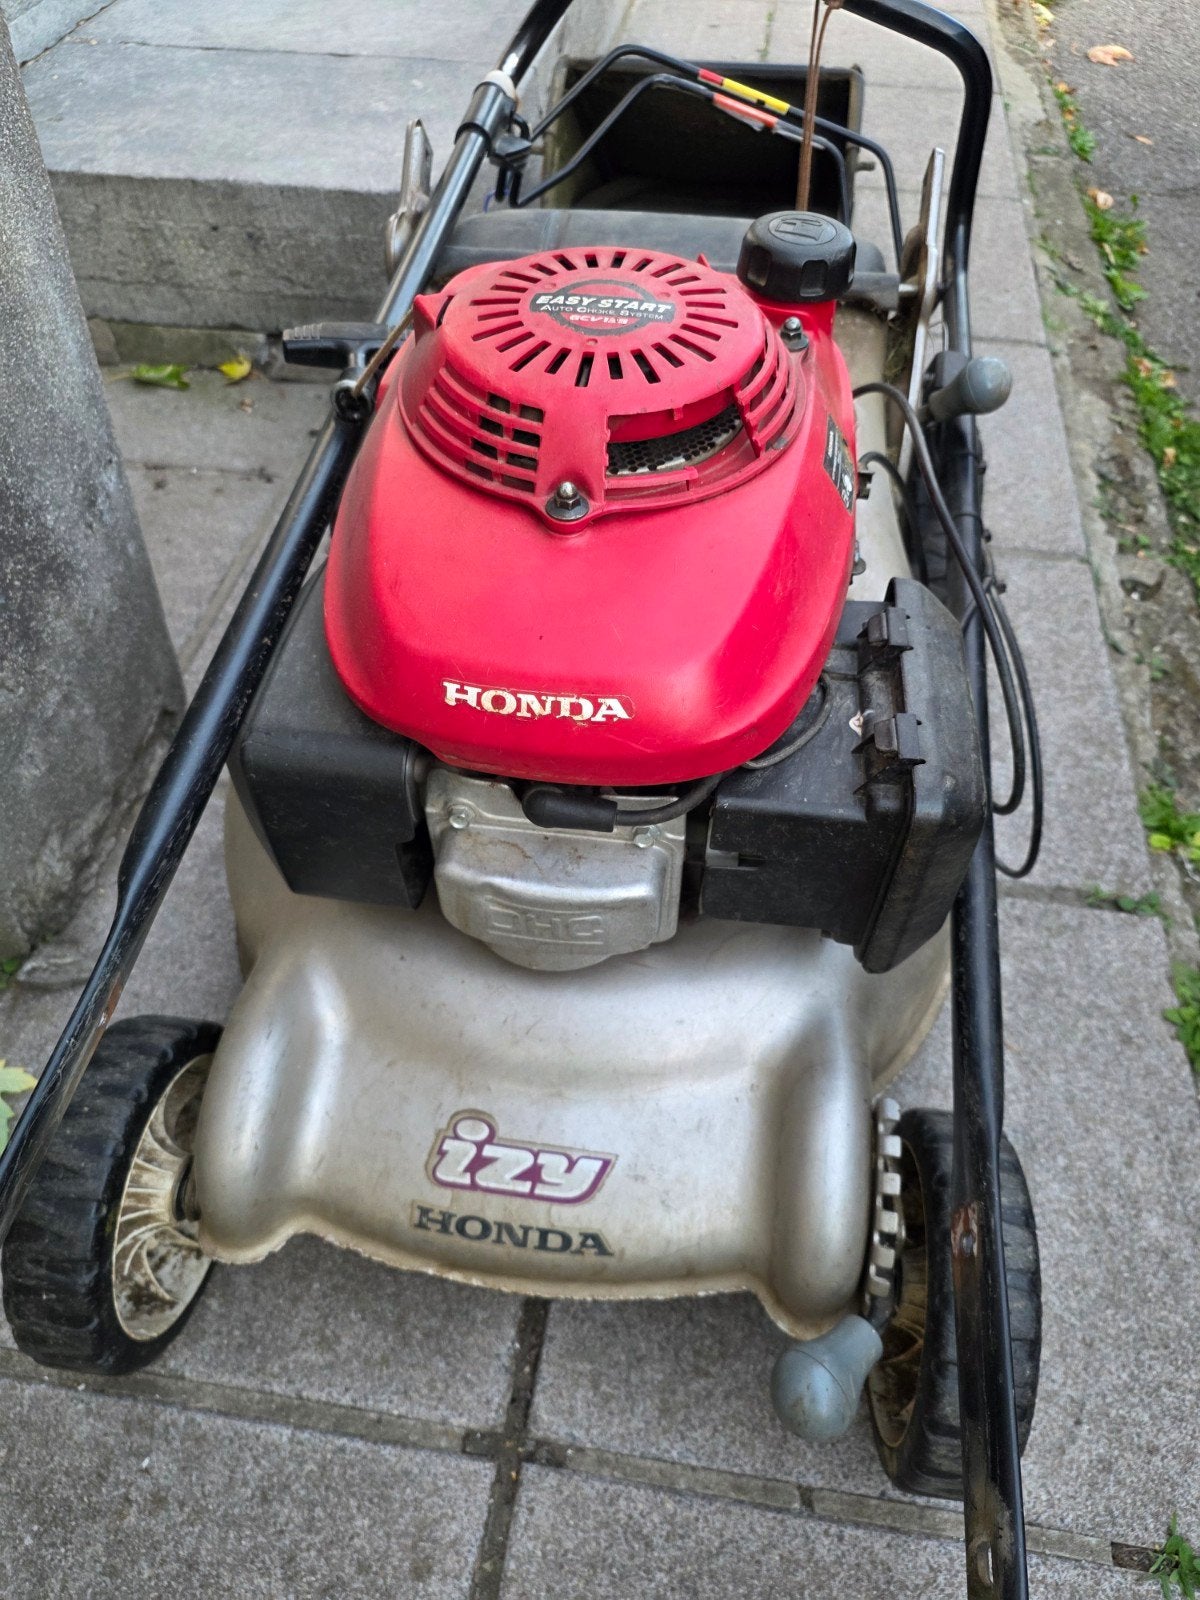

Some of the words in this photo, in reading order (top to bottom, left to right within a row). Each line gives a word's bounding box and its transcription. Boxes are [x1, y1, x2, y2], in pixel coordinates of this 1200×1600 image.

[535, 295, 597, 306] EASY
[598, 299, 672, 313] START
[442, 681, 630, 723] HONDA
[487, 904, 605, 943] OHC
[433, 1117, 609, 1202] izy
[414, 1204, 615, 1257] HONDA
